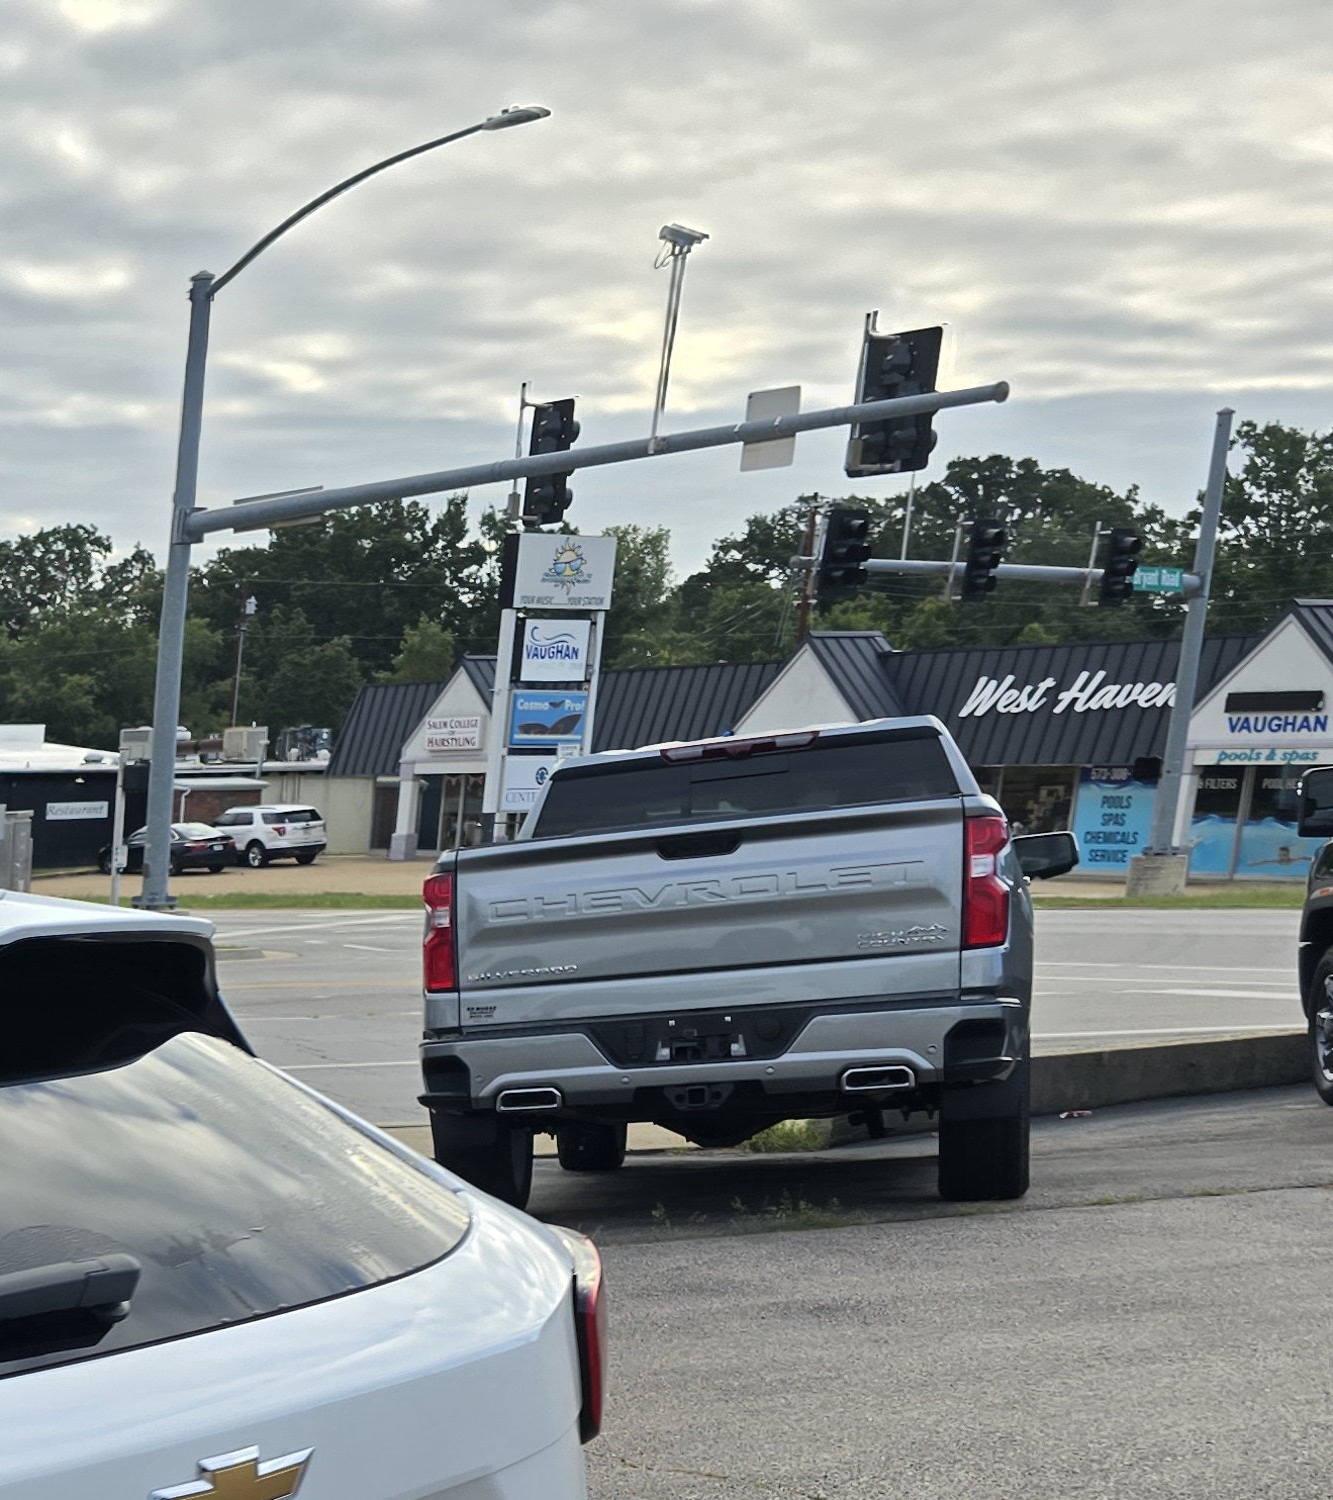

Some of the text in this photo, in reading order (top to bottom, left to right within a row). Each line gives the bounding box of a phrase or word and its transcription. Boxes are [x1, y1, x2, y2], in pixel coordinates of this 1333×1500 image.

[526, 644, 580, 661] VAUGHAN
[958, 674, 1057, 718] West
[517, 699, 549, 710] Cosmo
[1228, 714, 1328, 733] VAUGHAN
[1215, 748, 1319, 766] pools & spas
[1100, 795, 1133, 809] POOLS
[48, 804, 105, 816] Restaurant
[1100, 813, 1127, 827] SPAS
[1083, 831, 1140, 845] CHEMICALS
[1087, 849, 1129, 863] SERVICE
[488, 860, 930, 924] CHEVROLET
